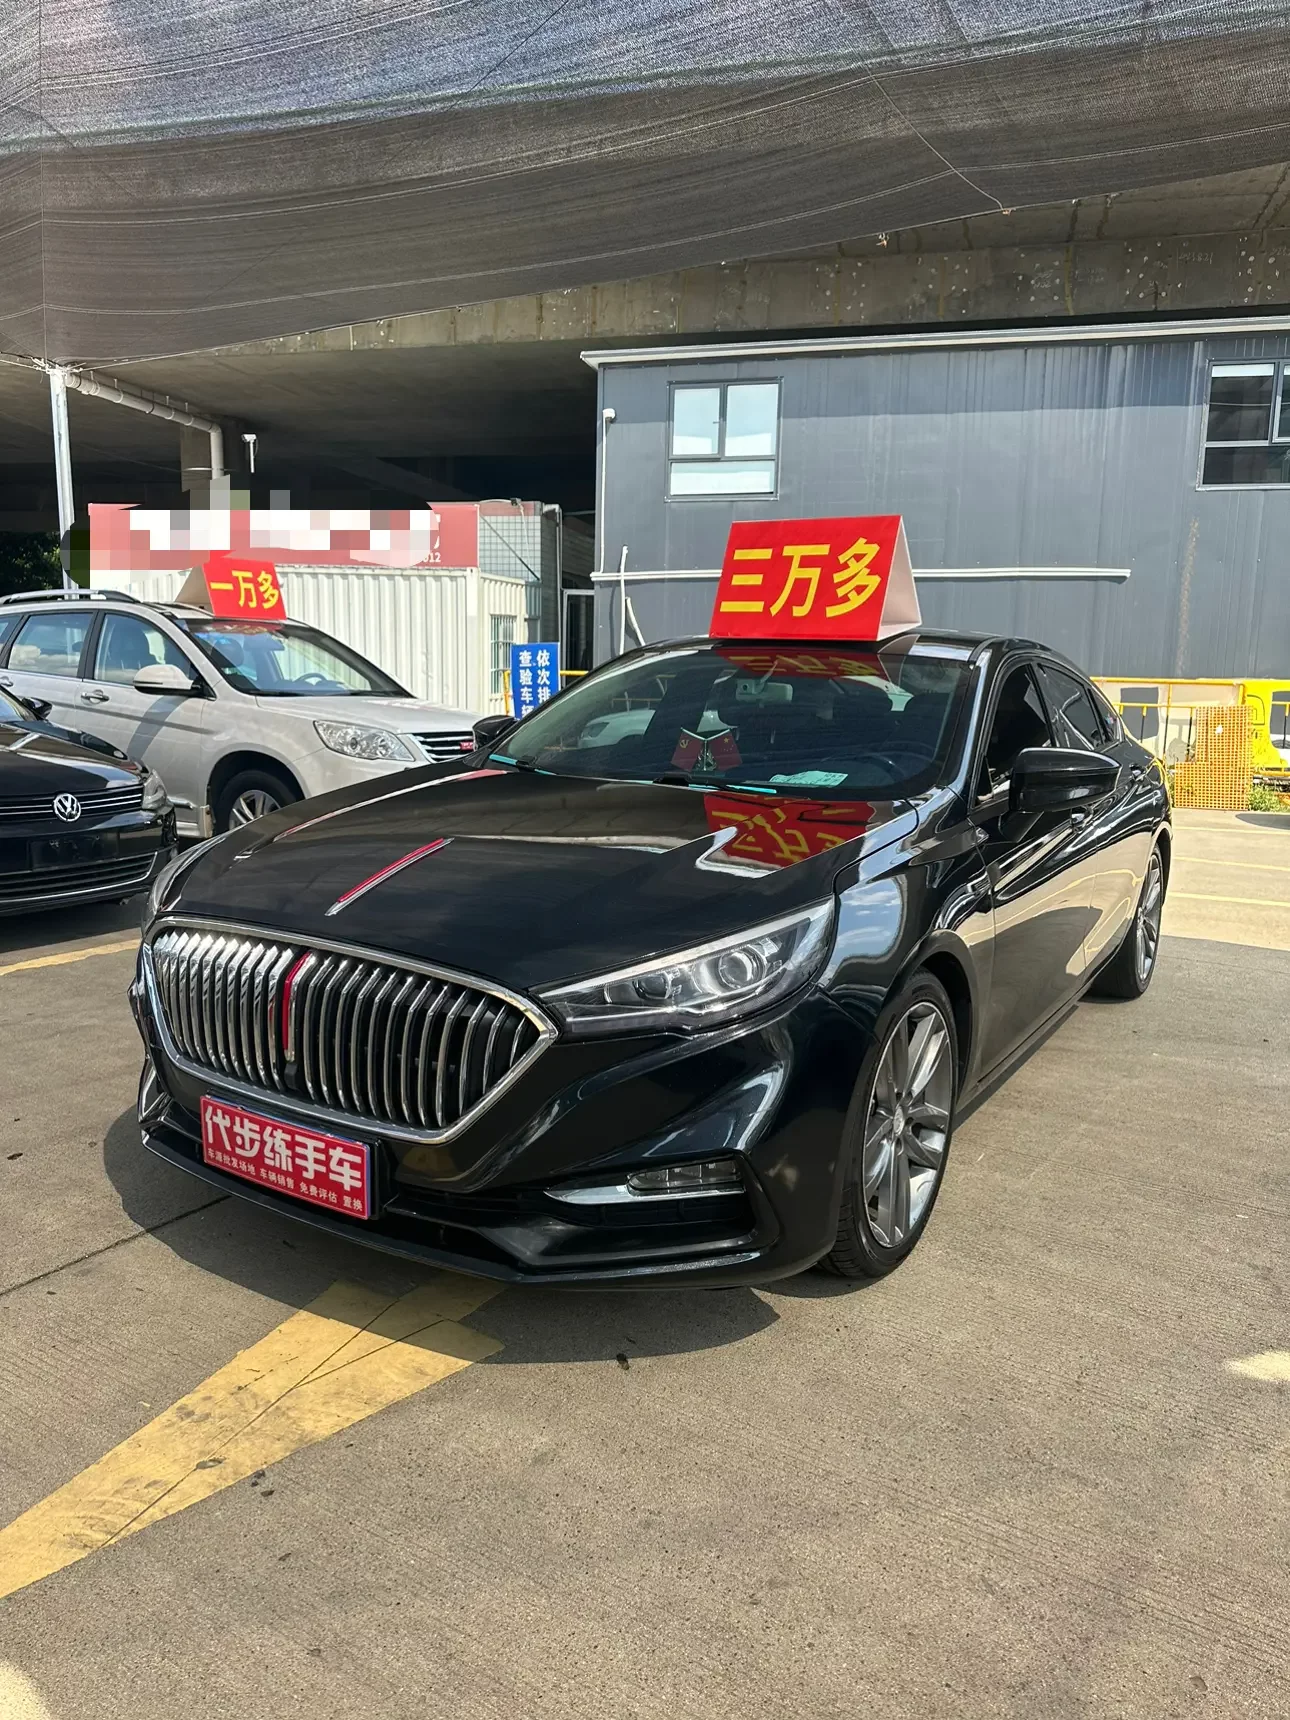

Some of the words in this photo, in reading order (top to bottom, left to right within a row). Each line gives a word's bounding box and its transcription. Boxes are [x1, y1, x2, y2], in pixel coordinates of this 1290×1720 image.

[209, 570, 279, 609] 一万多
[719, 537, 882, 618] 三万多
[205, 1105, 362, 1192] 代步练手车
[207, 1147, 256, 1177] 车源批发场地
[260, 1167, 295, 1191] 车辆销售
[299, 1181, 338, 1205] 免费评估
[343, 1195, 363, 1212] 置换
